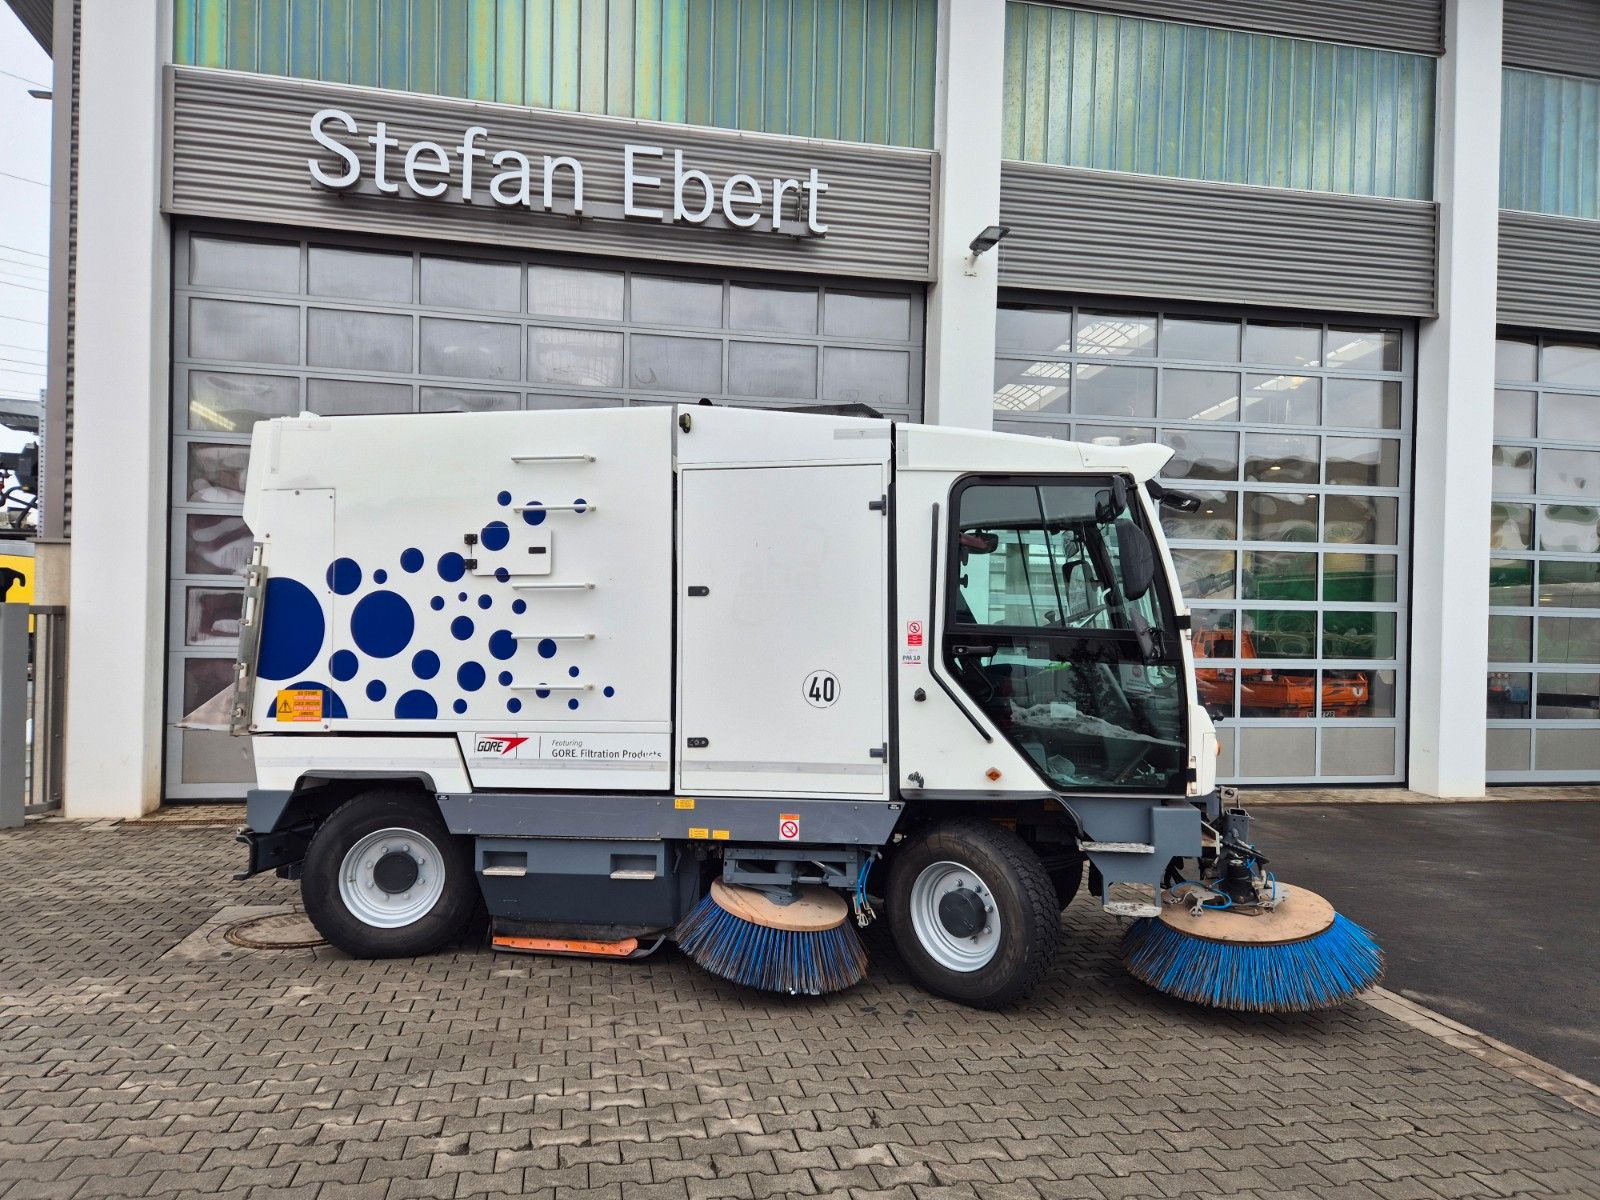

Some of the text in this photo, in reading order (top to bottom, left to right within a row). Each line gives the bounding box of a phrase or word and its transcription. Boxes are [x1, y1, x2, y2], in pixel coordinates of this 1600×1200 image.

[307, 108, 829, 236] Stefan Ebert
[808, 676, 835, 702] 40
[477, 741, 503, 752] GORE
[551, 739, 583, 748] Featuring
[551, 749, 576, 758] GORE
[580, 749, 620, 758] Filtration
